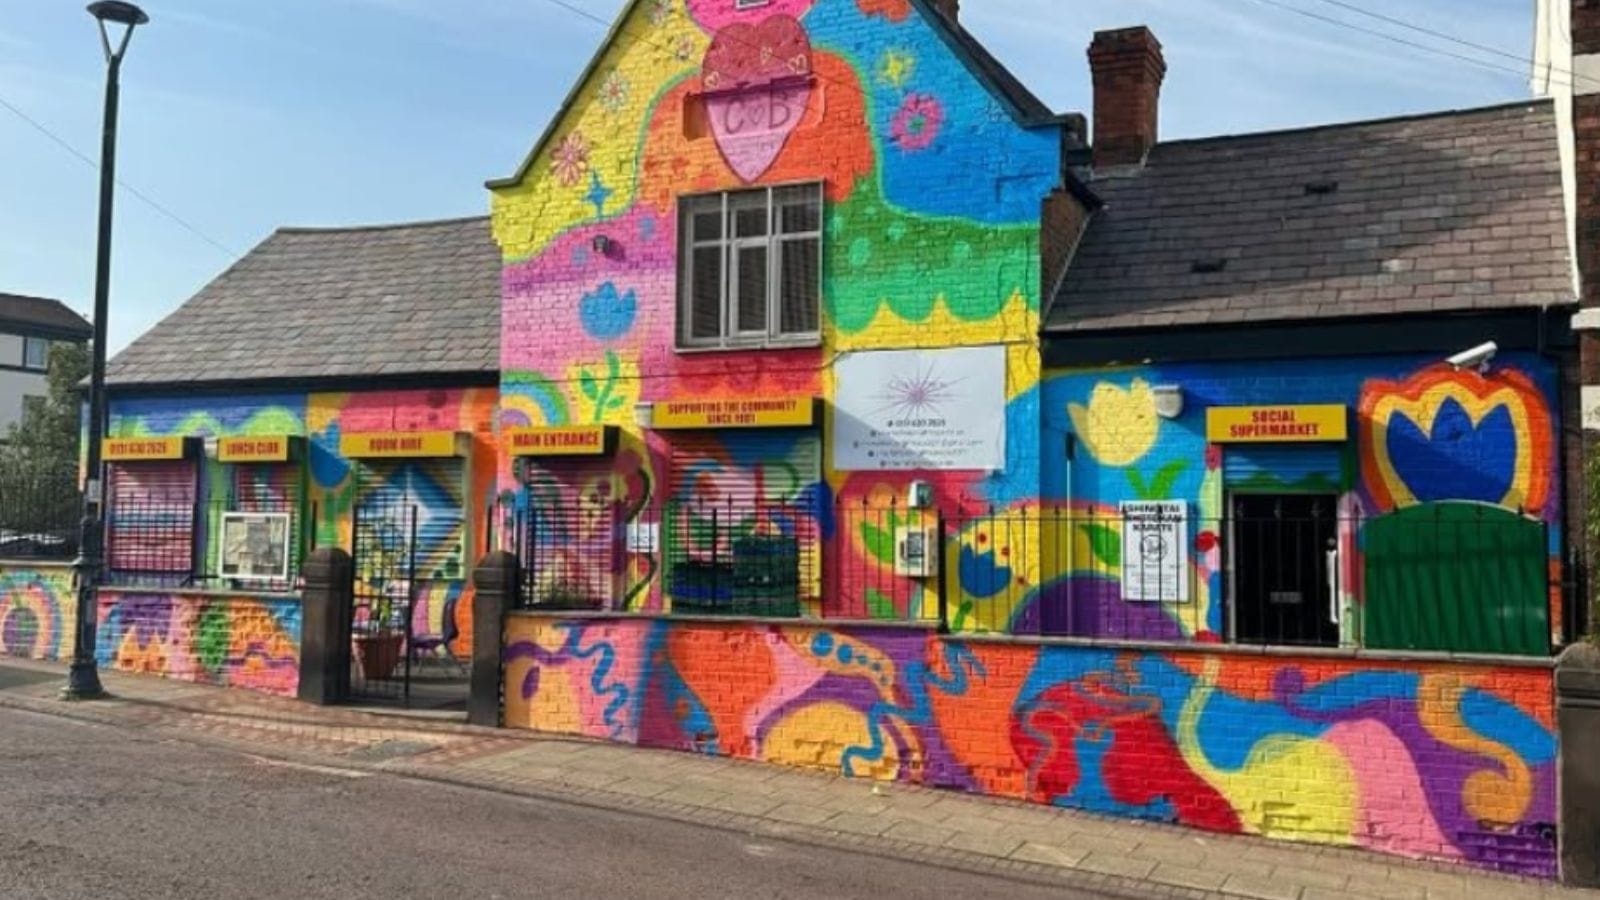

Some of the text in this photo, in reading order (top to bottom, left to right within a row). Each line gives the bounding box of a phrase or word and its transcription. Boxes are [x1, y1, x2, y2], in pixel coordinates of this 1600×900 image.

[668, 400, 797, 414] SUPPORTING THE COMMUNITY
[706, 413, 732, 424] SINCE
[1252, 409, 1296, 422] SOCIAL
[1229, 423, 1319, 437] SUPERMARKET
[369, 437, 422, 452] ROOM HIRE
[513, 430, 599, 448] MAIN ENTRANCE
[226, 442, 255, 456] LUNCH
